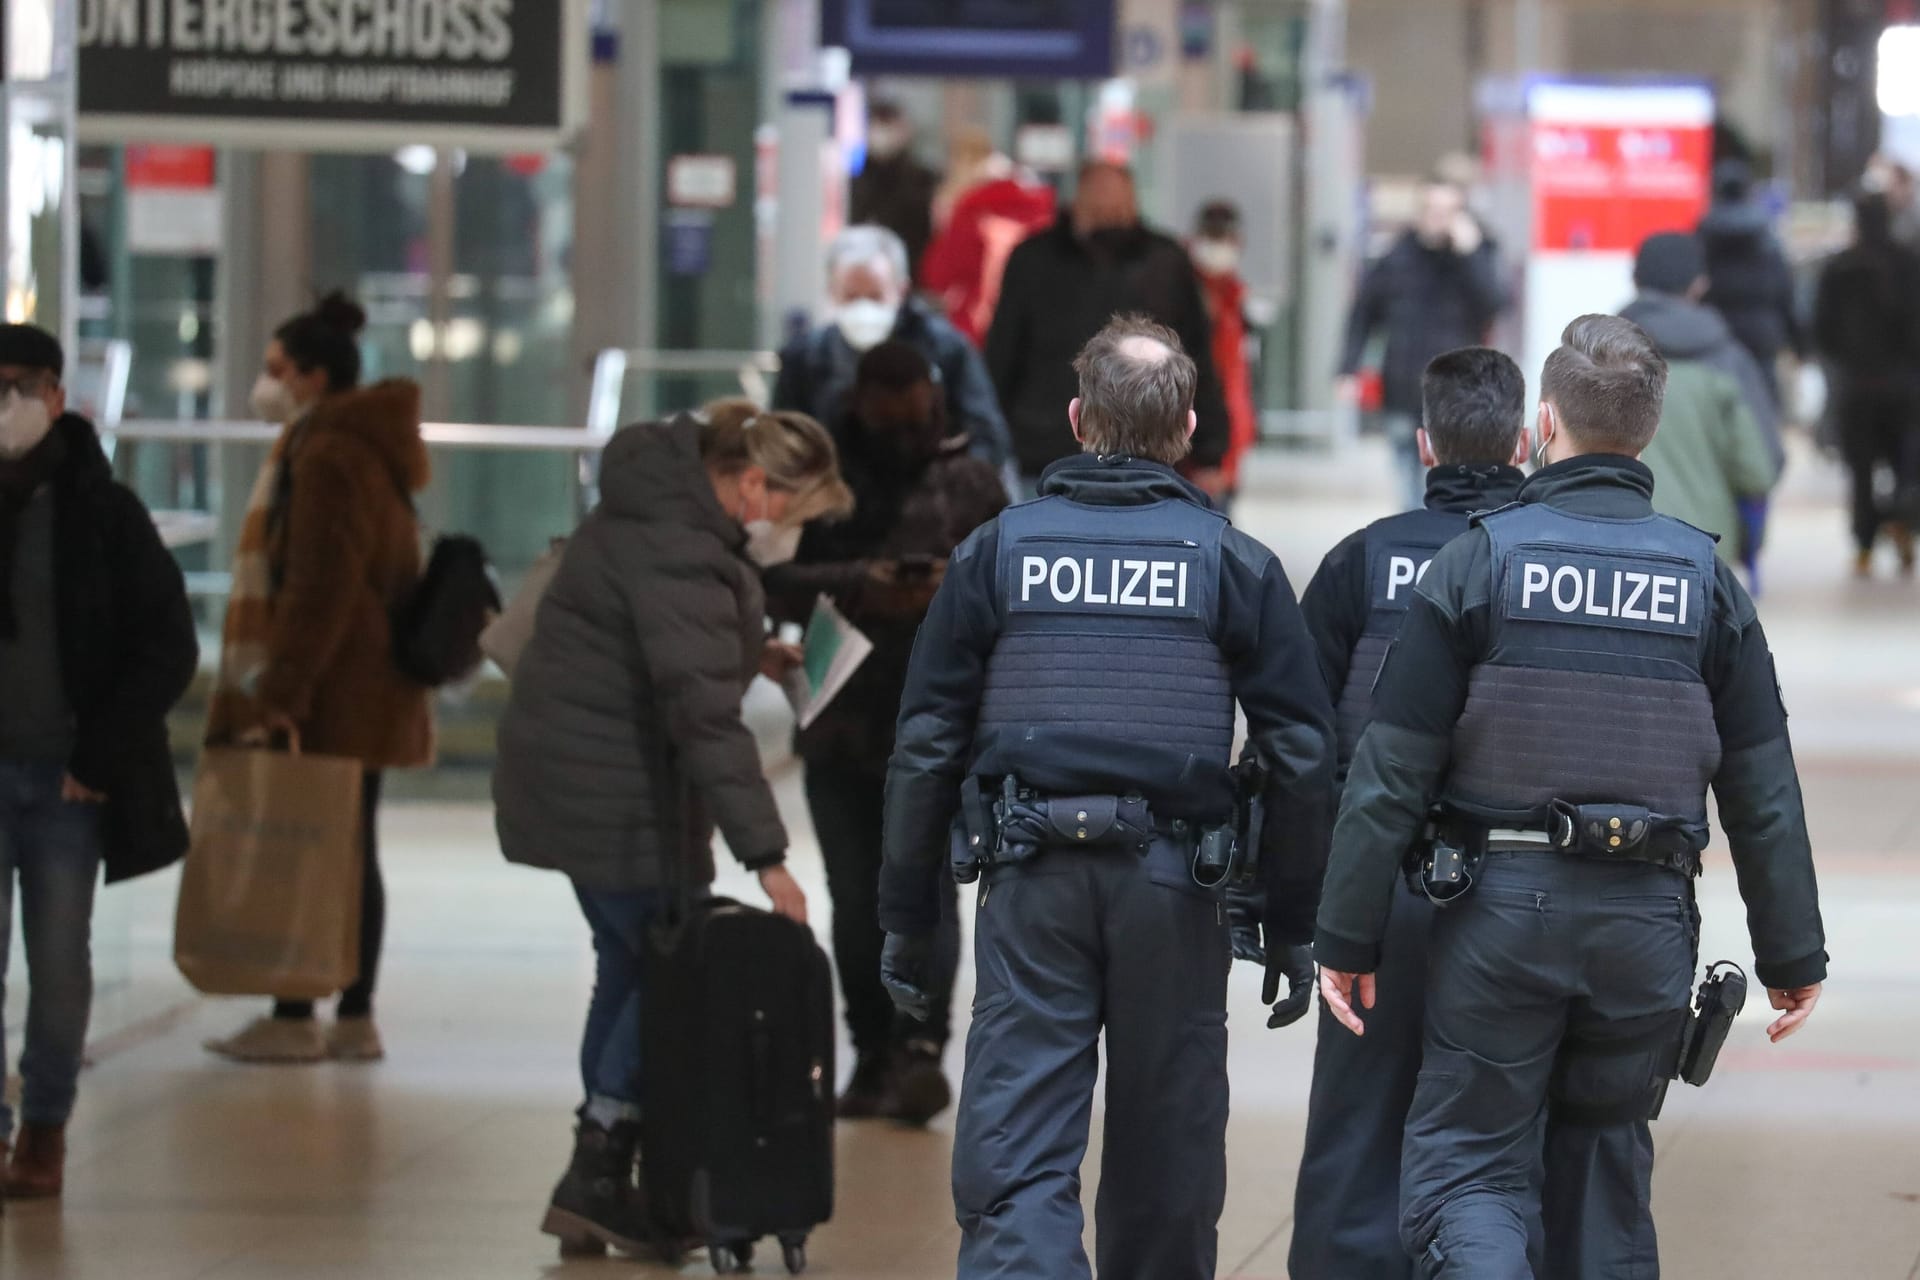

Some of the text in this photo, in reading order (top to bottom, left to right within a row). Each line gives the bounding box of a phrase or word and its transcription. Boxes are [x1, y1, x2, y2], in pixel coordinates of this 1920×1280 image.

[279, 64, 326, 101] UND
[335, 66, 514, 106] HAUPTBAHNHOF
[1021, 556, 1188, 607] POLIZEI
[1386, 556, 1433, 600] P
[1521, 562, 1689, 625] POLIZEI
